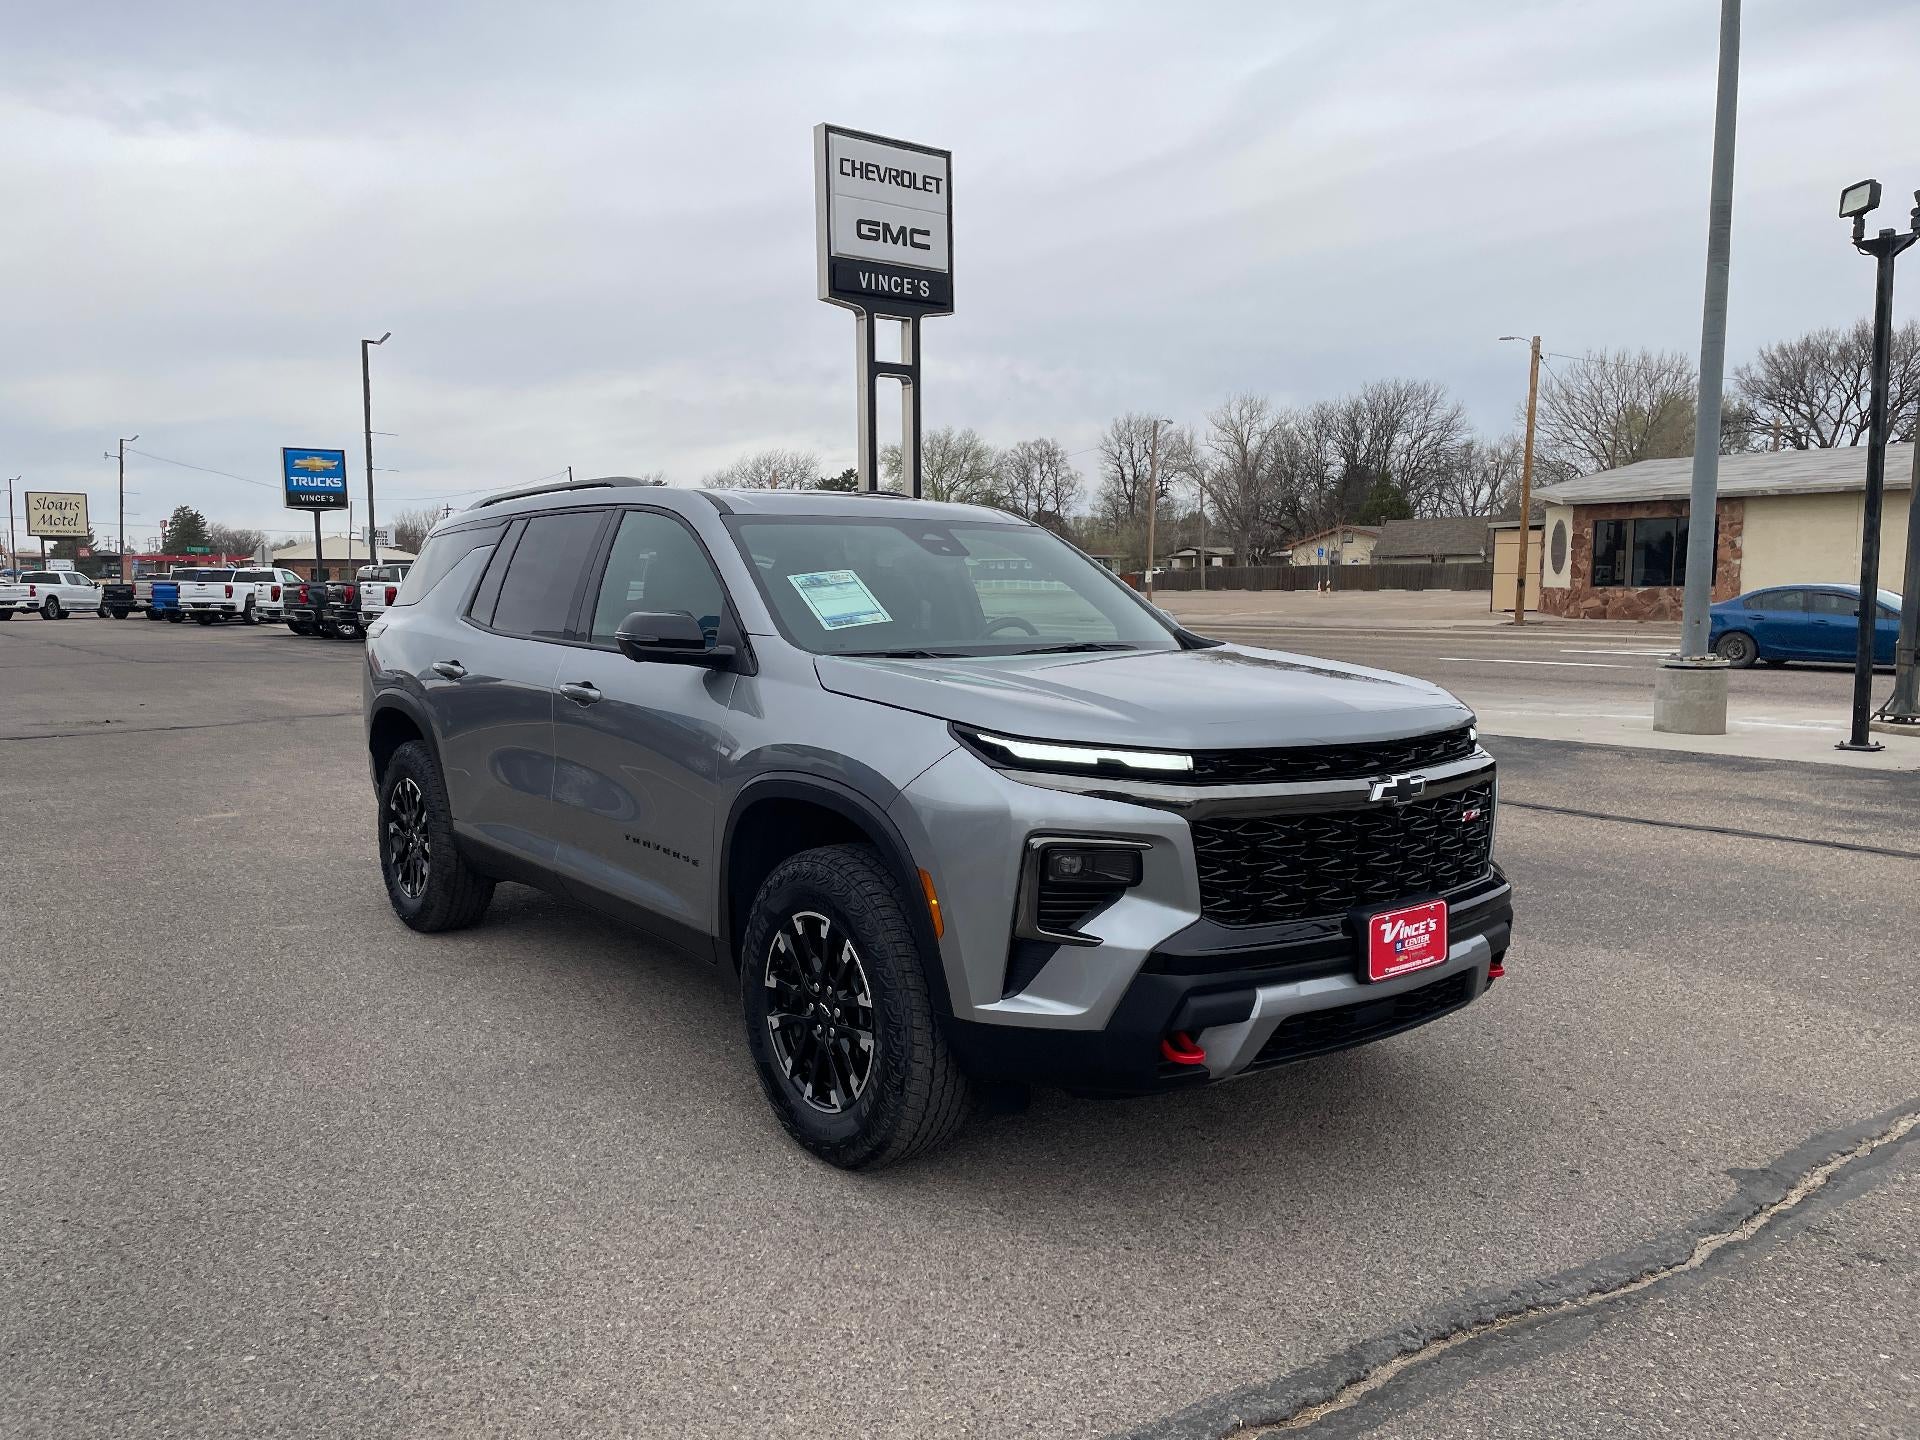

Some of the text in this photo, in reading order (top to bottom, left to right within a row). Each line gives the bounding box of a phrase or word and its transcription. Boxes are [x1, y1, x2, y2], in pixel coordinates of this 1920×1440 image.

[839, 157, 943, 194] CHEVROLET
[856, 218, 931, 251] GMC
[859, 271, 930, 298] VINCE'S
[290, 476, 342, 488] TRUCKS
[33, 496, 80, 511] Sloans
[300, 494, 335, 503] VINCE'S
[36, 513, 79, 527] Motel
[1404, 933, 1430, 948] CENTER
